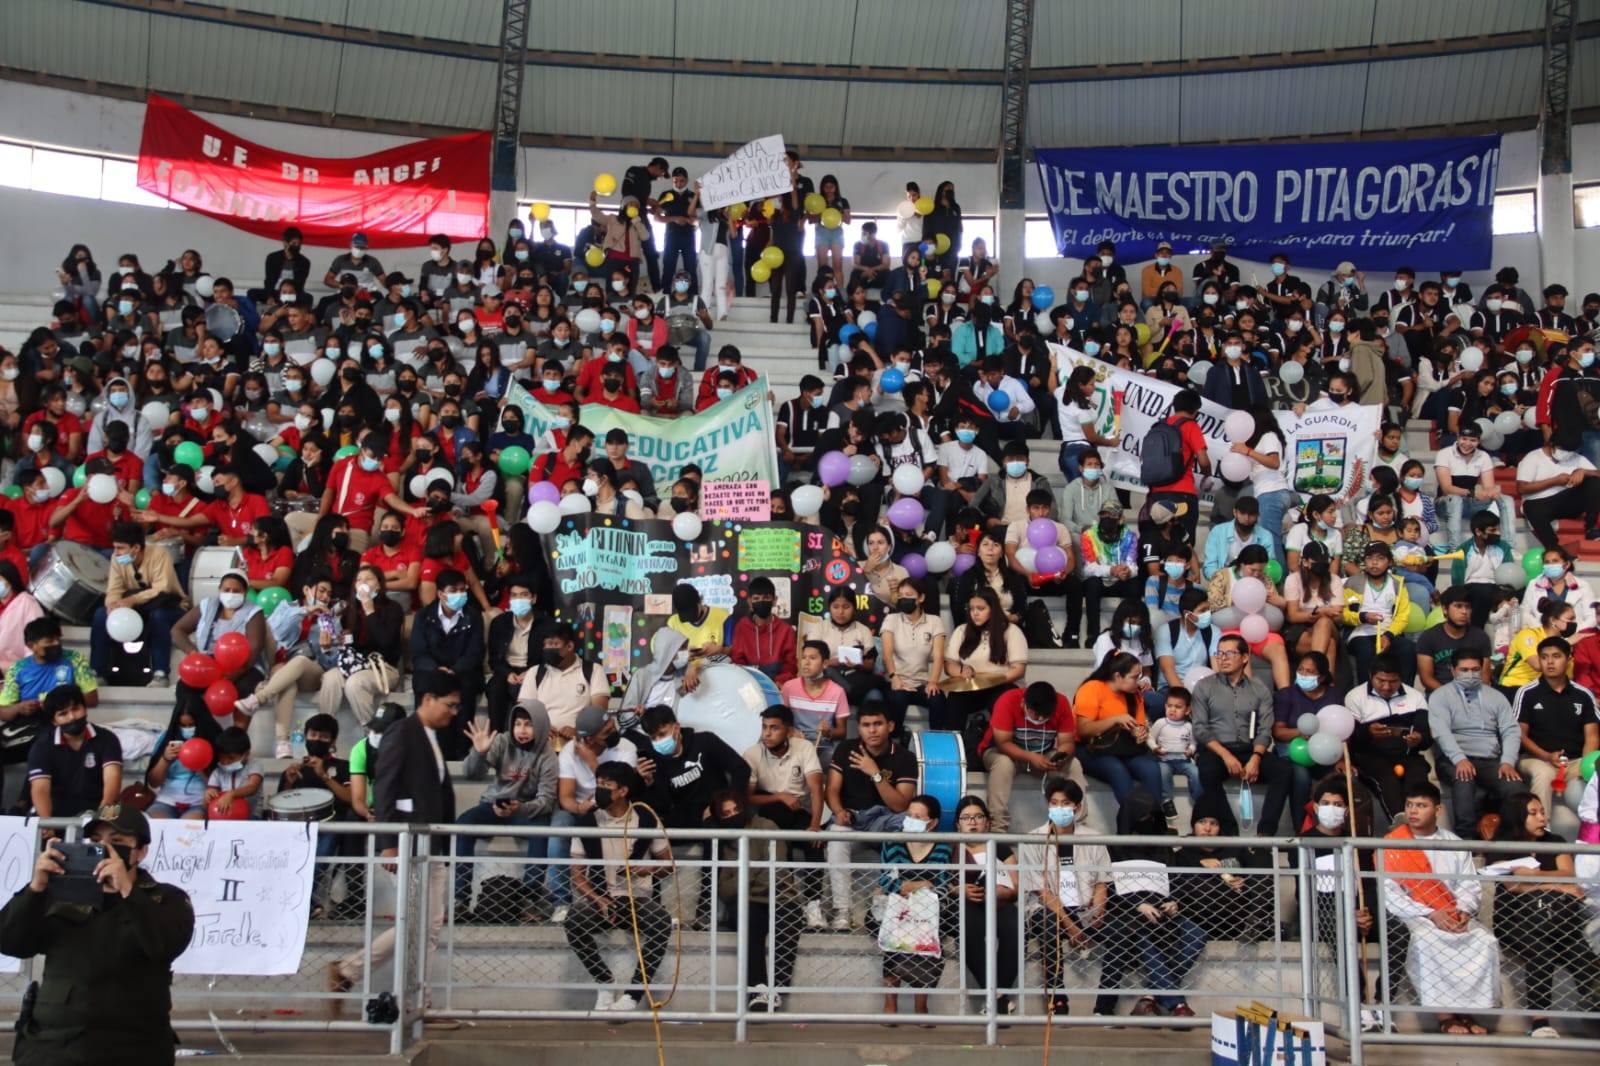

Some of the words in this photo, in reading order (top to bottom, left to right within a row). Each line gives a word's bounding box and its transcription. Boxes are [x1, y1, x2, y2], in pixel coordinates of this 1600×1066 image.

[1062, 229, 1076, 245] El
[1359, 222, 1456, 249] triunfar!
[1122, 380, 1173, 417] UNIDA
[1286, 423, 1303, 435] LA
[1304, 415, 1359, 432] GUARDIA
[650, 453, 719, 484] CRZ
[807, 532, 824, 550] SI
[1143, 543, 1152, 556] 7
[808, 596, 824, 614] ES
[150, 830, 216, 884] Angel
